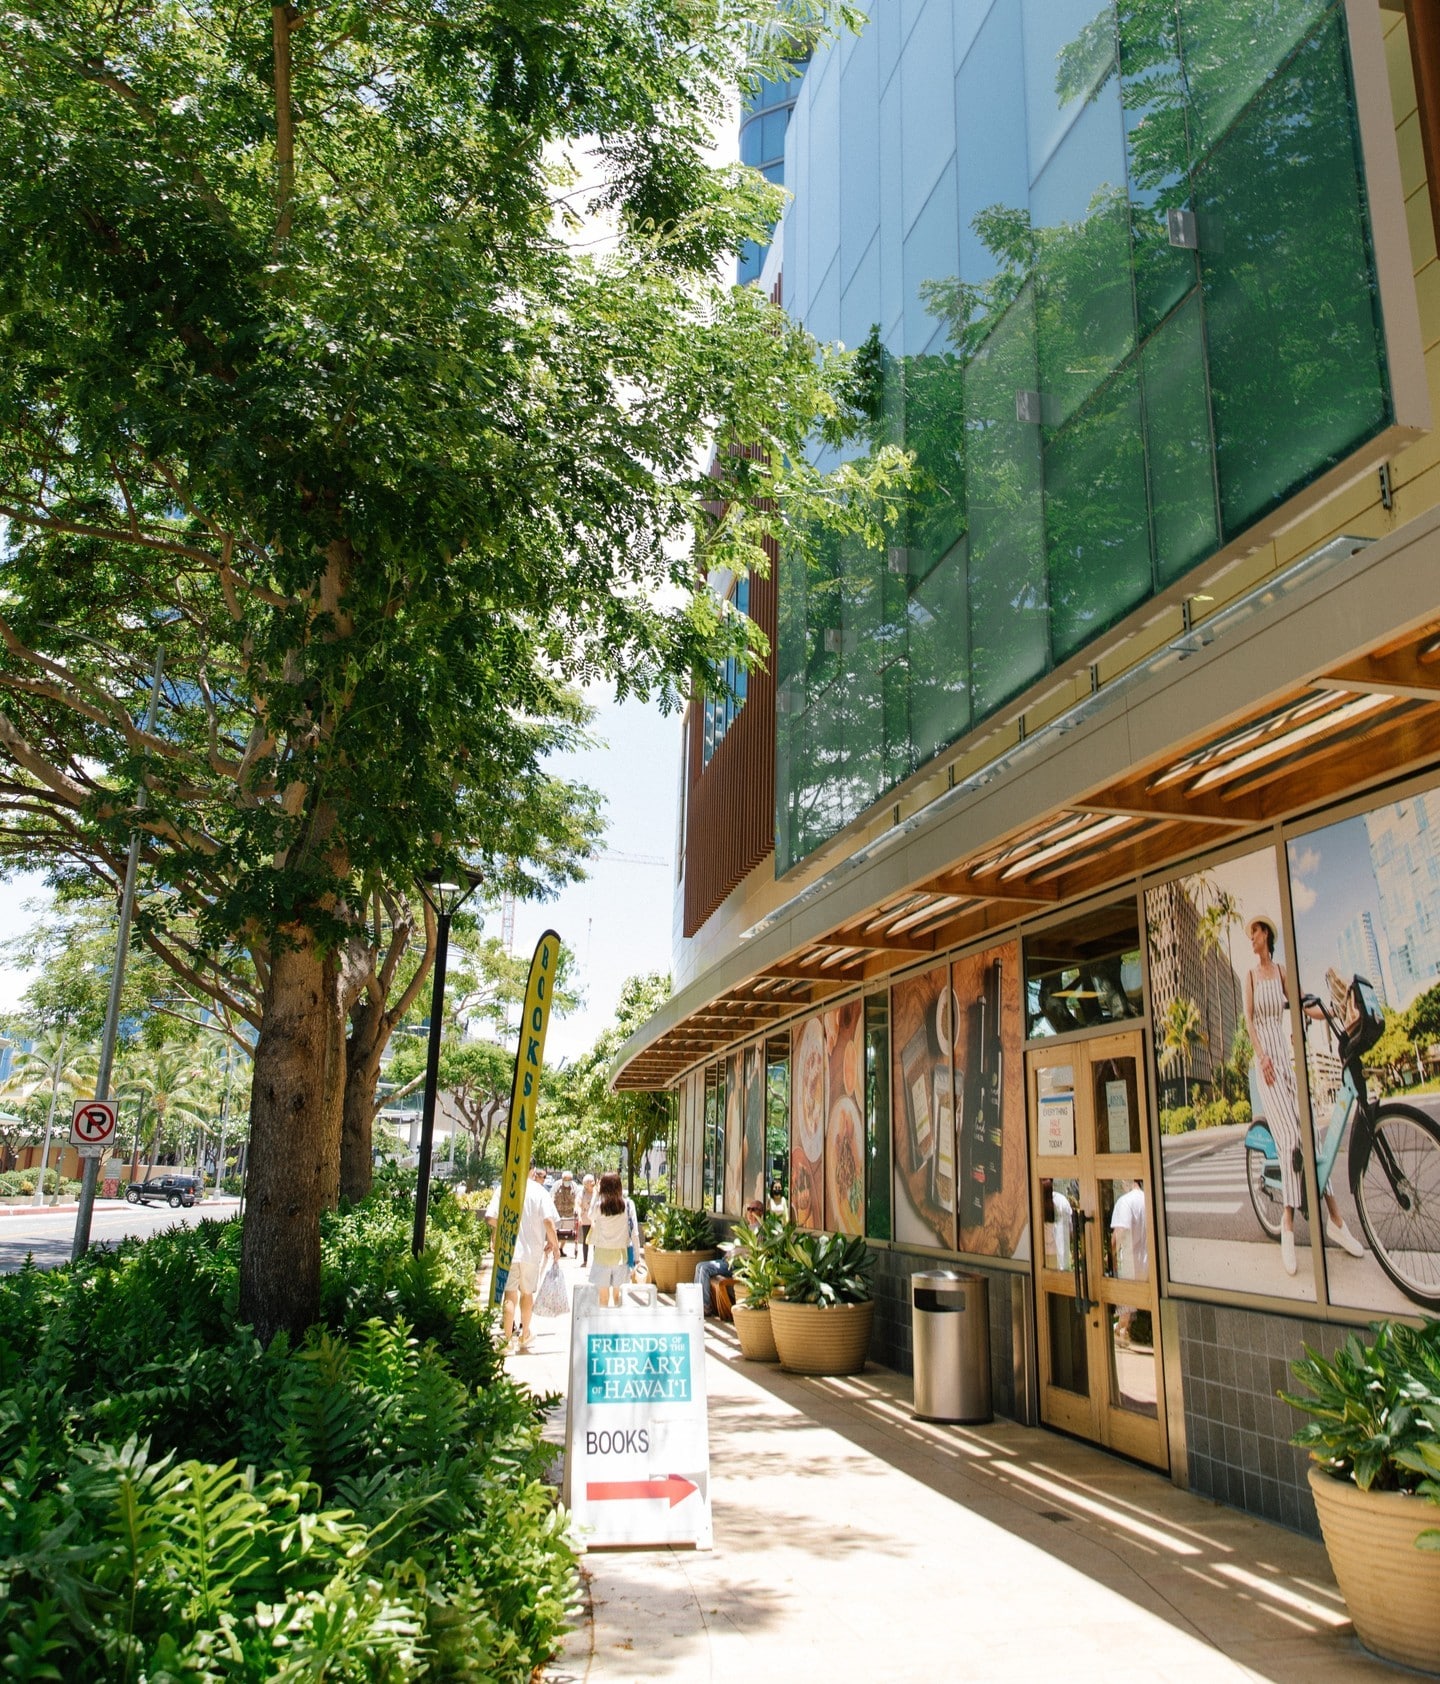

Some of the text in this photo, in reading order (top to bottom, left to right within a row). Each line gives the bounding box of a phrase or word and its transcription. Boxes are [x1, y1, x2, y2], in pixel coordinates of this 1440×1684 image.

[591, 1336, 683, 1353] FRIENDS OF
[670, 1343, 685, 1352] THE
[591, 1356, 685, 1376] LIBRARY
[591, 1386, 603, 1395] OF
[586, 1429, 649, 1455] BOOKS
